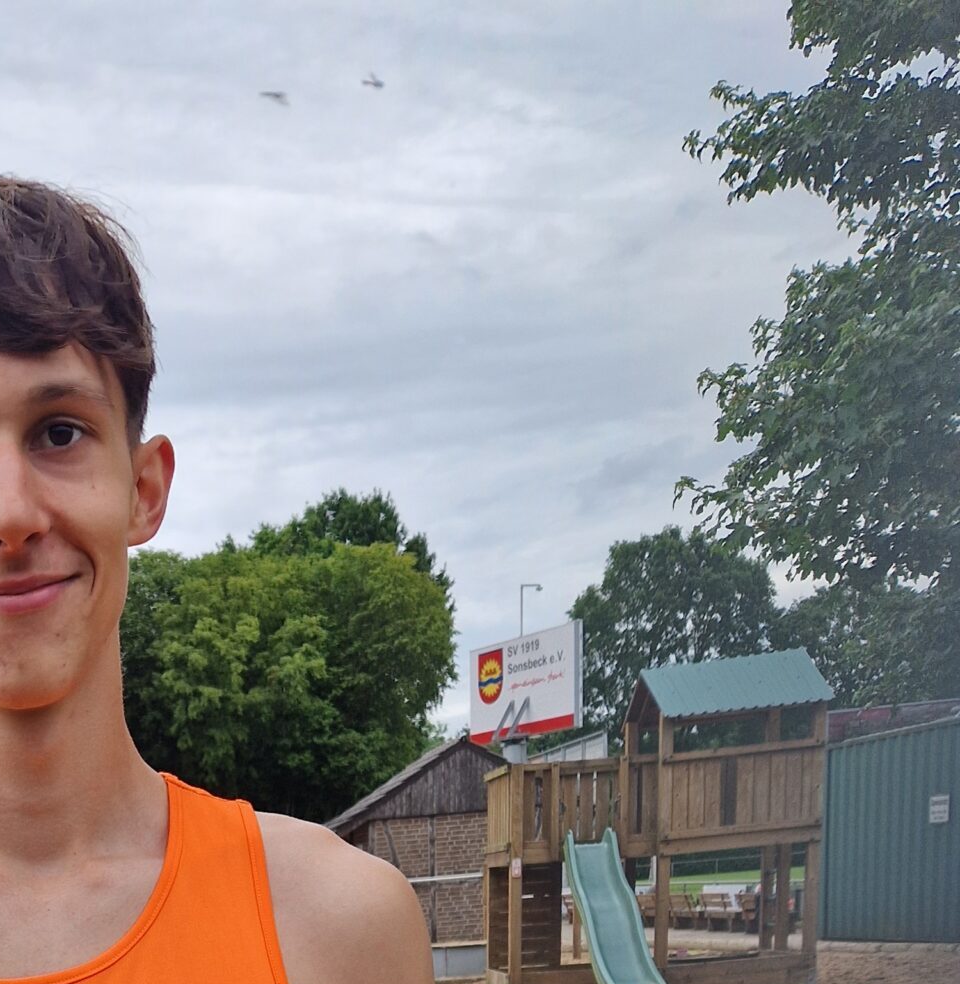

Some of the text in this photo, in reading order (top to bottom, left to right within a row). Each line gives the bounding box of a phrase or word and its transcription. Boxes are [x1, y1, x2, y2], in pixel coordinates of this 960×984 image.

[507, 639, 540, 657] SV 1919
[507, 655, 548, 675] Sonsbeck
